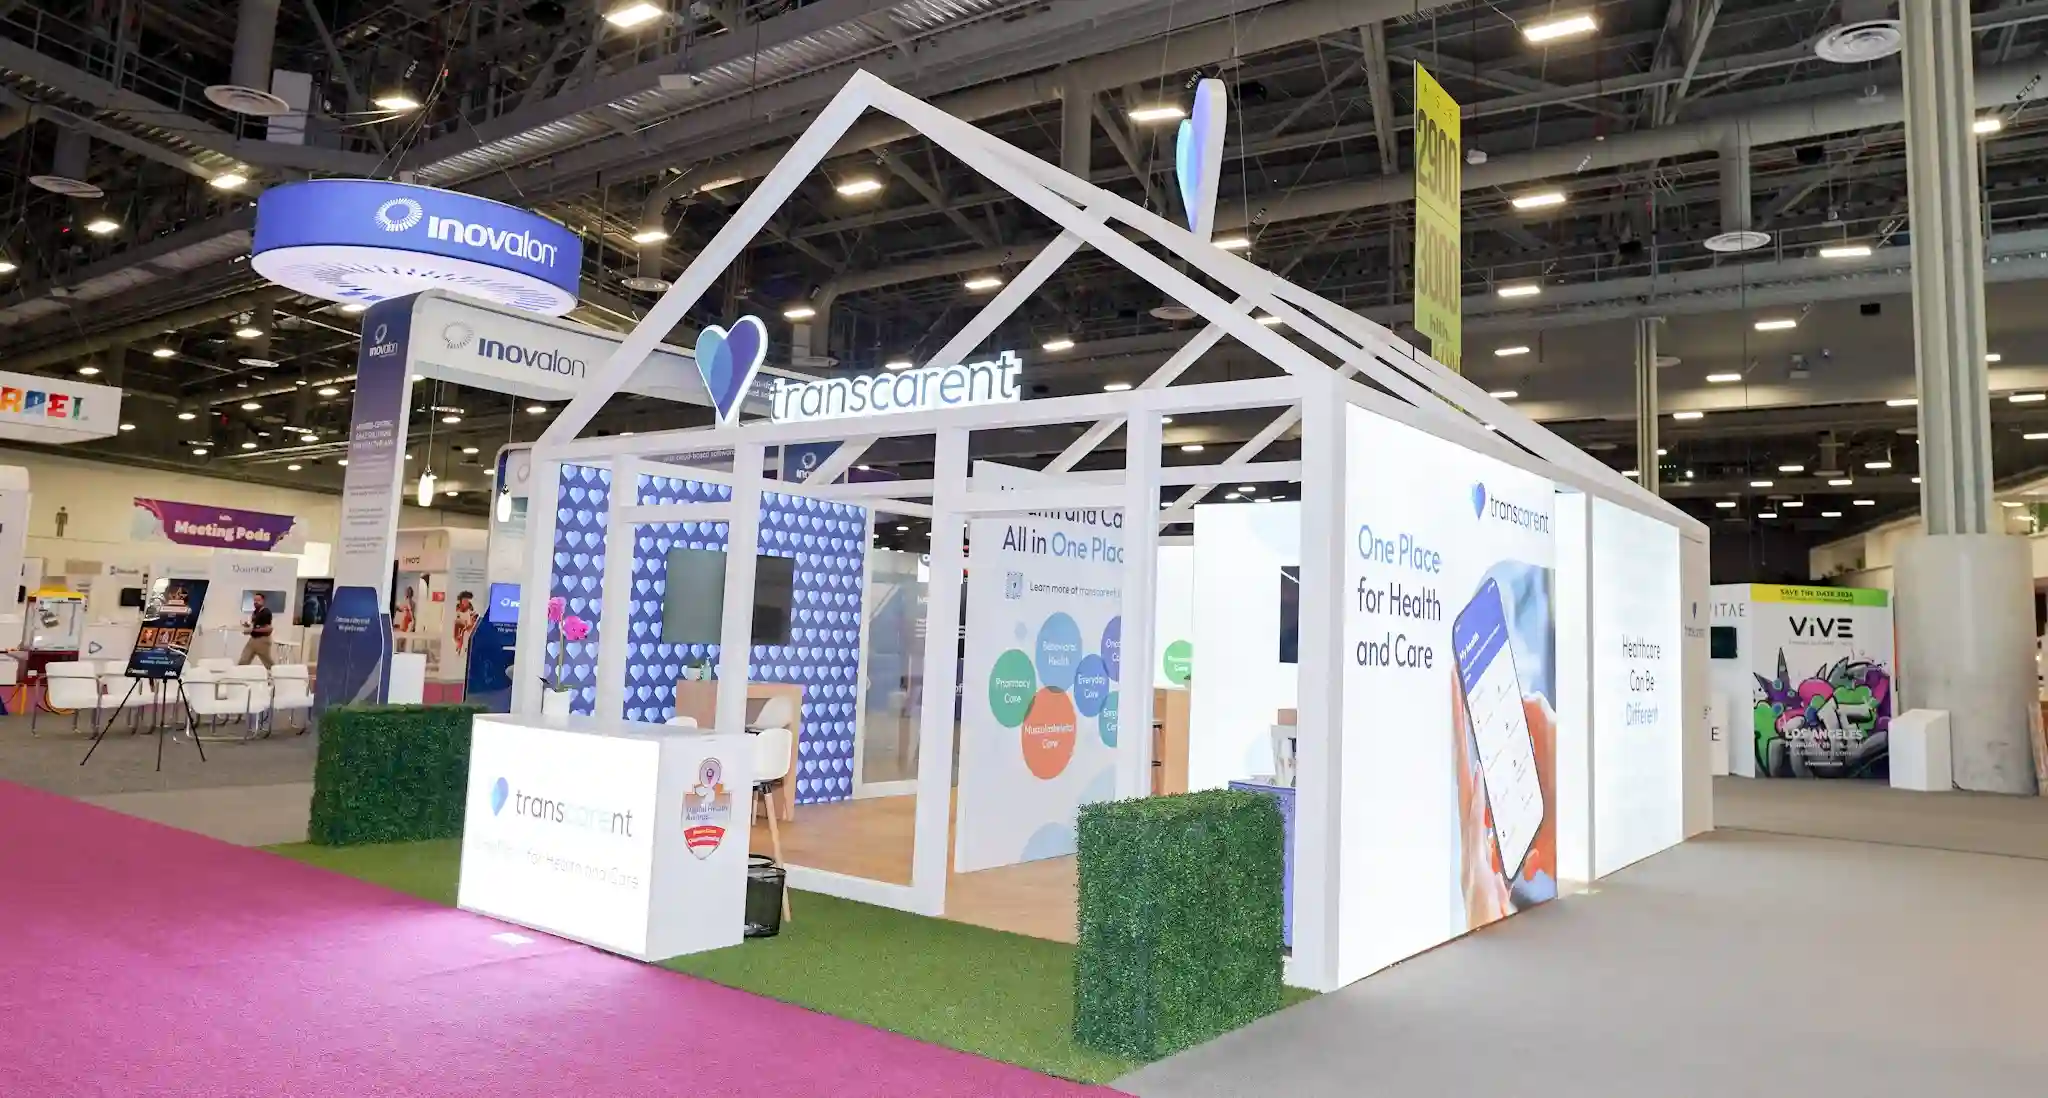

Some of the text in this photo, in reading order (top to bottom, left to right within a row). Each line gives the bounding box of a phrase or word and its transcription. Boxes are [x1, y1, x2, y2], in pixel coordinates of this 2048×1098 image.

[1418, 108, 1457, 211] 2900
[427, 214, 557, 268] inovalon
[1418, 219, 1459, 314] 3000
[369, 340, 399, 357] inovalon
[478, 338, 586, 378] inovalon
[771, 352, 1016, 421] transcarent
[1490, 493, 1549, 534] transcarent
[174, 519, 271, 542] Meeting Pods
[1002, 525, 1027, 551] All
[1032, 528, 1047, 555] in
[1052, 532, 1087, 560] One
[1358, 524, 1441, 574] One Place
[1029, 581, 1050, 595] Learn
[1051, 584, 1069, 595] more
[1357, 576, 1441, 621] for Health
[1710, 602, 1746, 618] ITAE
[1789, 615, 1854, 638] ViVE
[1356, 632, 1433, 669] and Care
[1622, 633, 1661, 660] Healthcare
[1048, 656, 1069, 666] Health
[995, 677, 1030, 689] Pharmacy
[1629, 669, 1655, 692] Can Be
[1004, 694, 1021, 704] Care
[1625, 702, 1659, 726] Different
[1041, 740, 1058, 749] Care
[1785, 728, 1862, 741] LOS ANGELES
[516, 789, 633, 837] transcarent
